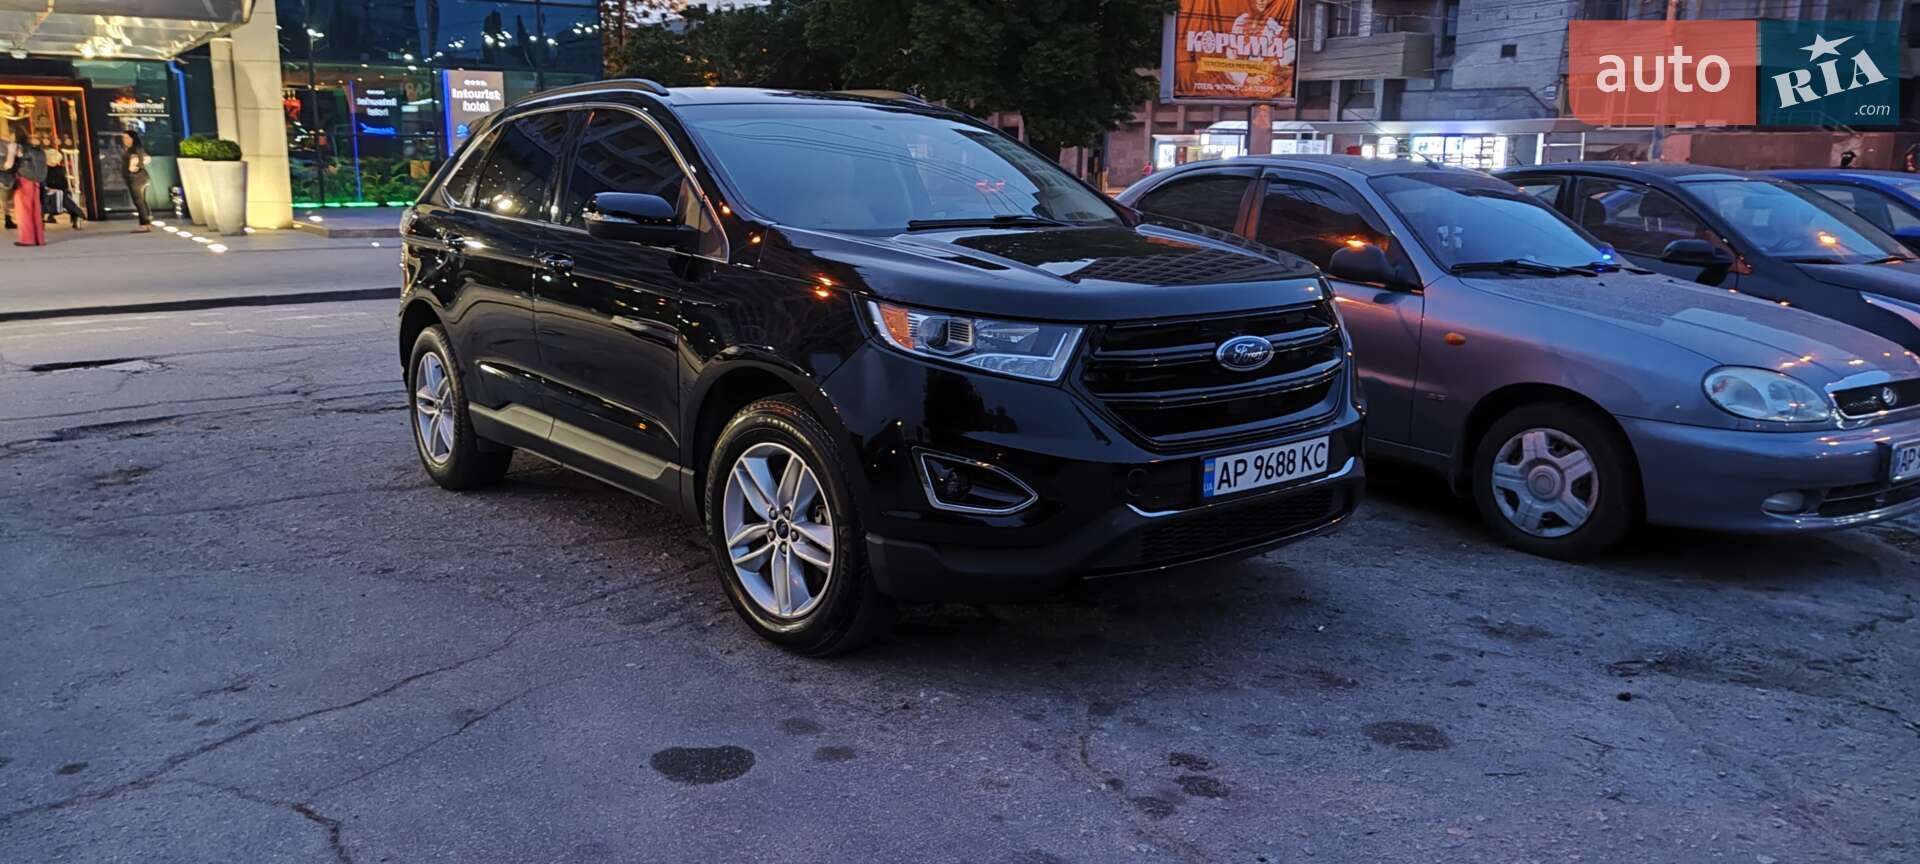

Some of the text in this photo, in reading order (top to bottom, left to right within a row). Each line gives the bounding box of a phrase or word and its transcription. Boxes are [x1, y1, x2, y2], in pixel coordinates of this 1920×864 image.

[1187, 31, 1284, 58] КОРЧМА
[451, 88, 501, 100] Intourist
[463, 101, 490, 112] hotel
[1233, 342, 1269, 364] Ford
[1217, 442, 1326, 490] AP 9688 KC
